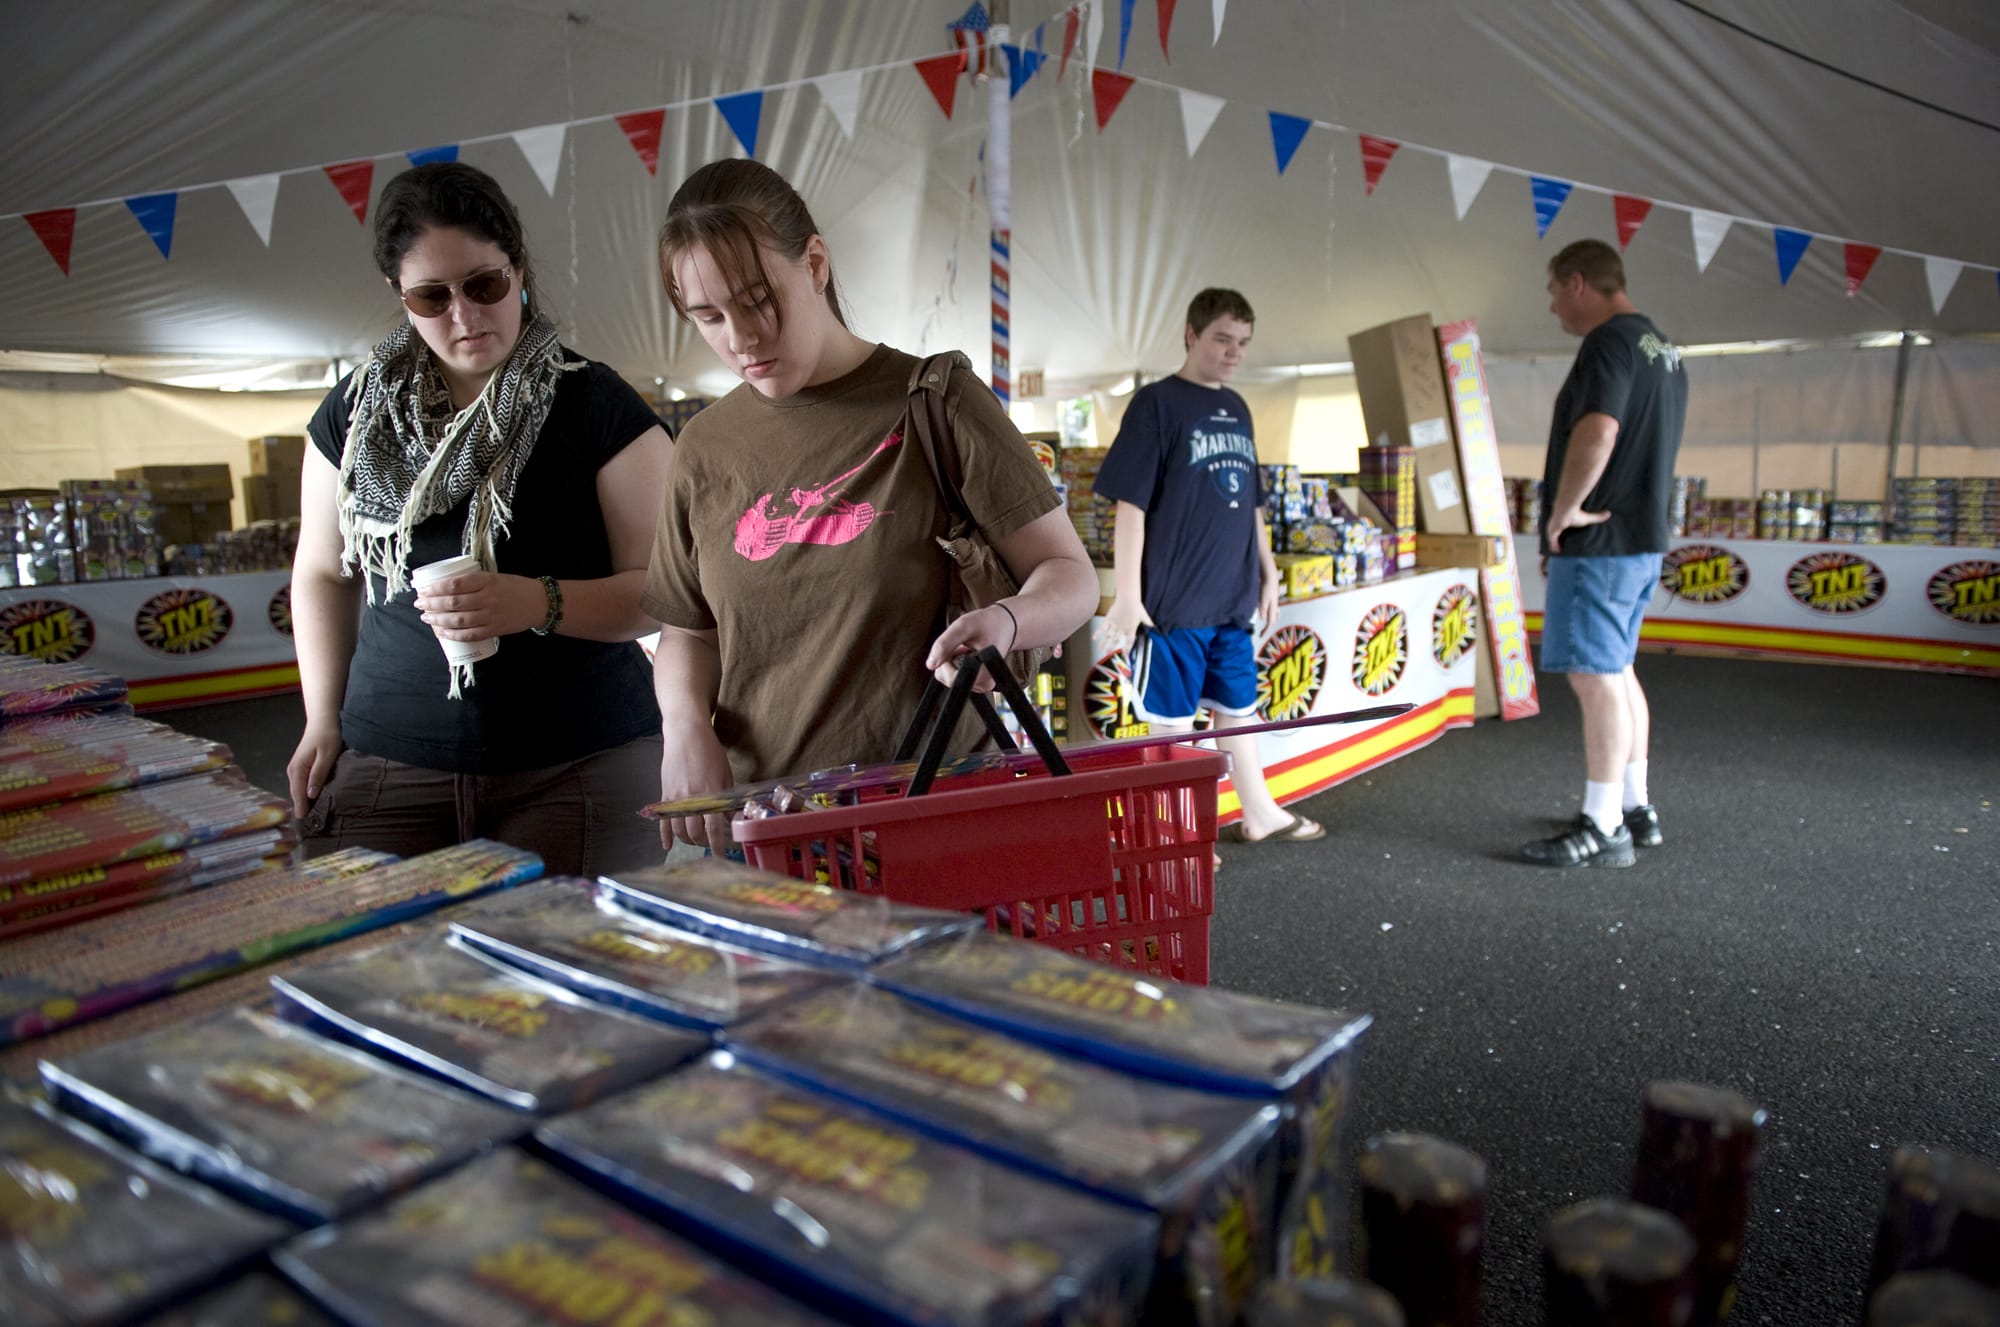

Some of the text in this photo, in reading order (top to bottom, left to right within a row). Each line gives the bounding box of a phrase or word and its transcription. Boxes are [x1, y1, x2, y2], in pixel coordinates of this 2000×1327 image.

[1681, 556, 1730, 589] TNT
[1812, 563, 1867, 596] TNT
[13, 609, 70, 654] TNT
[161, 597, 211, 639] TNT
[1366, 612, 1403, 675] TNT
[1269, 636, 1314, 706] TNT
